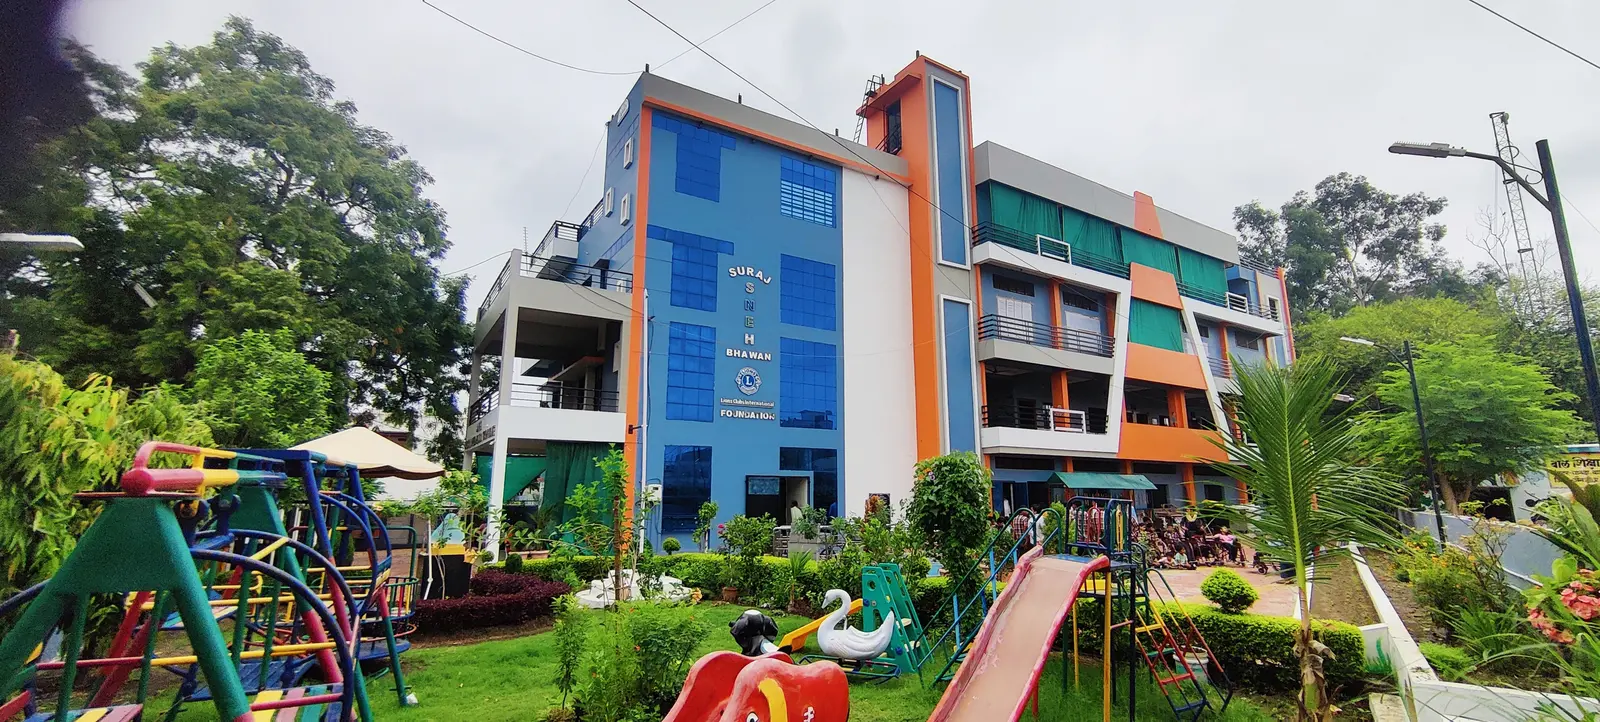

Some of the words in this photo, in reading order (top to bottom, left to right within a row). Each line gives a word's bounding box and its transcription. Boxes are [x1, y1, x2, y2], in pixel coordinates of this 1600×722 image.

[728, 266, 772, 285] SURAJ
[726, 348, 772, 361] BHAWAN
[745, 375, 753, 386] L
[720, 409, 776, 420] FOUNDATION
